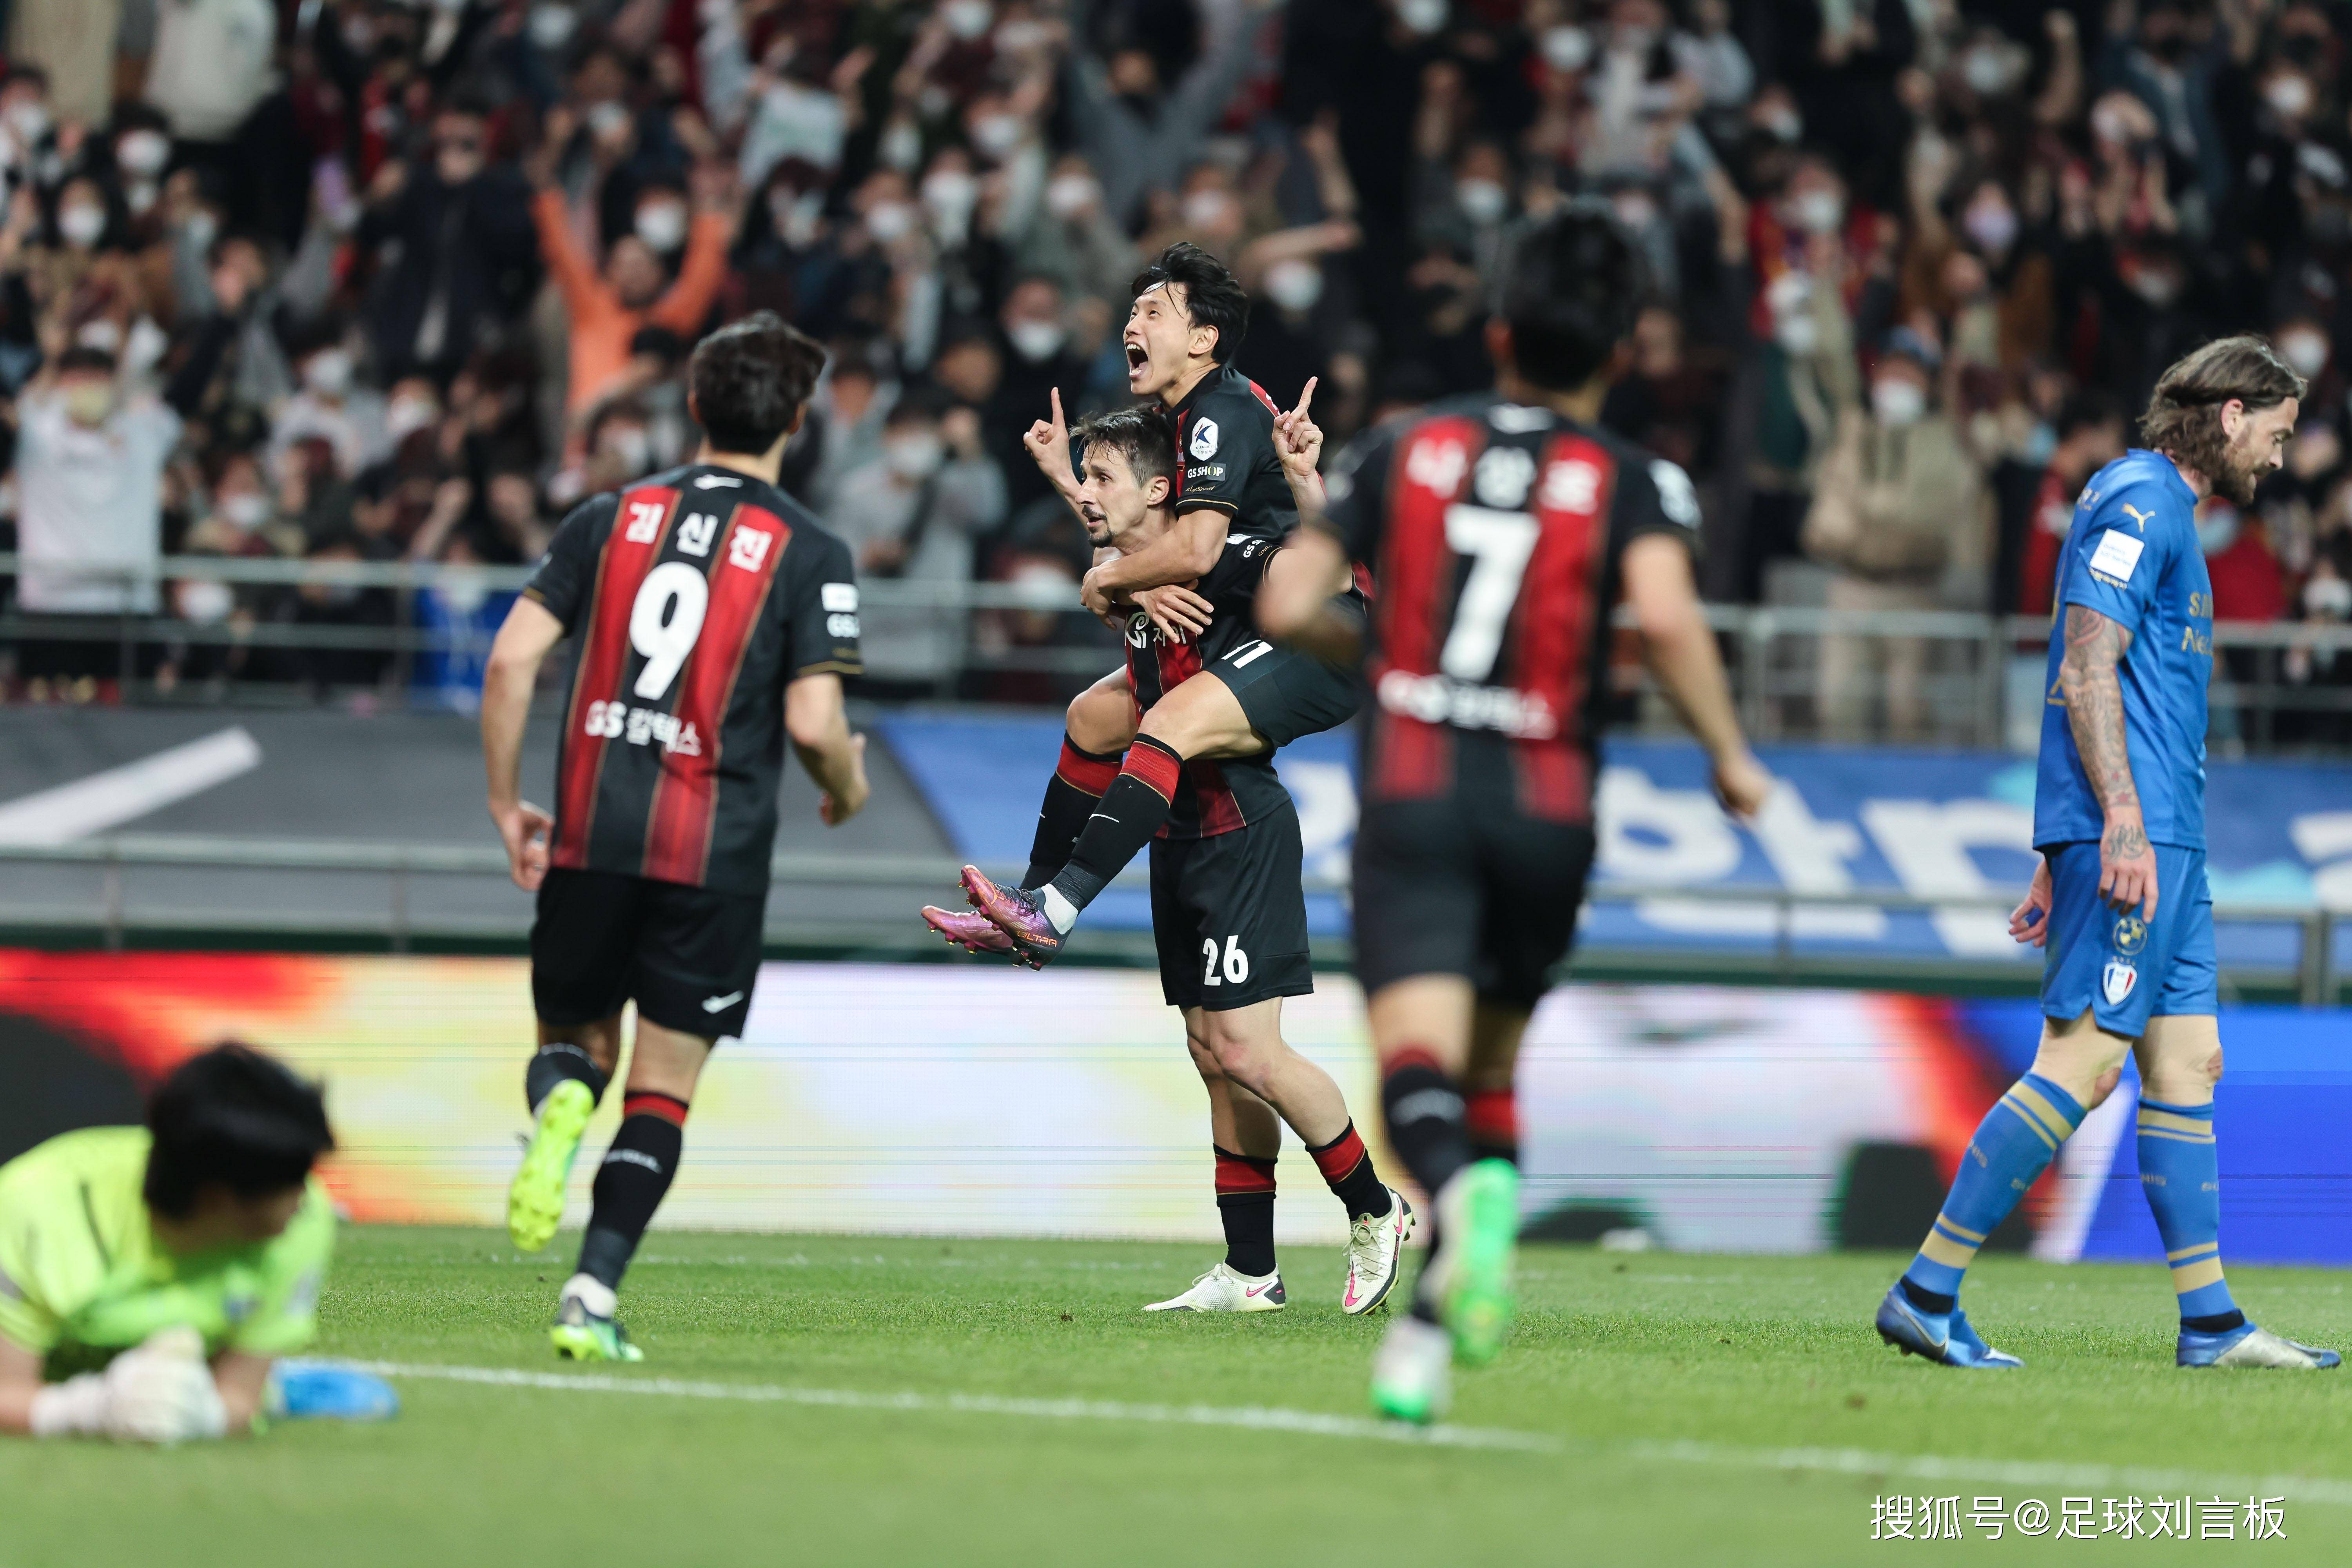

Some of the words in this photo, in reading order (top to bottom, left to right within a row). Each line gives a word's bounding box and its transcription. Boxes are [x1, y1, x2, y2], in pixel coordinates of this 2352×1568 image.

[629, 562, 708, 700] 9
[1439, 502, 1542, 681] 7
[1017, 931, 1057, 947] ULTRA
[1203, 935, 1249, 986] 26
